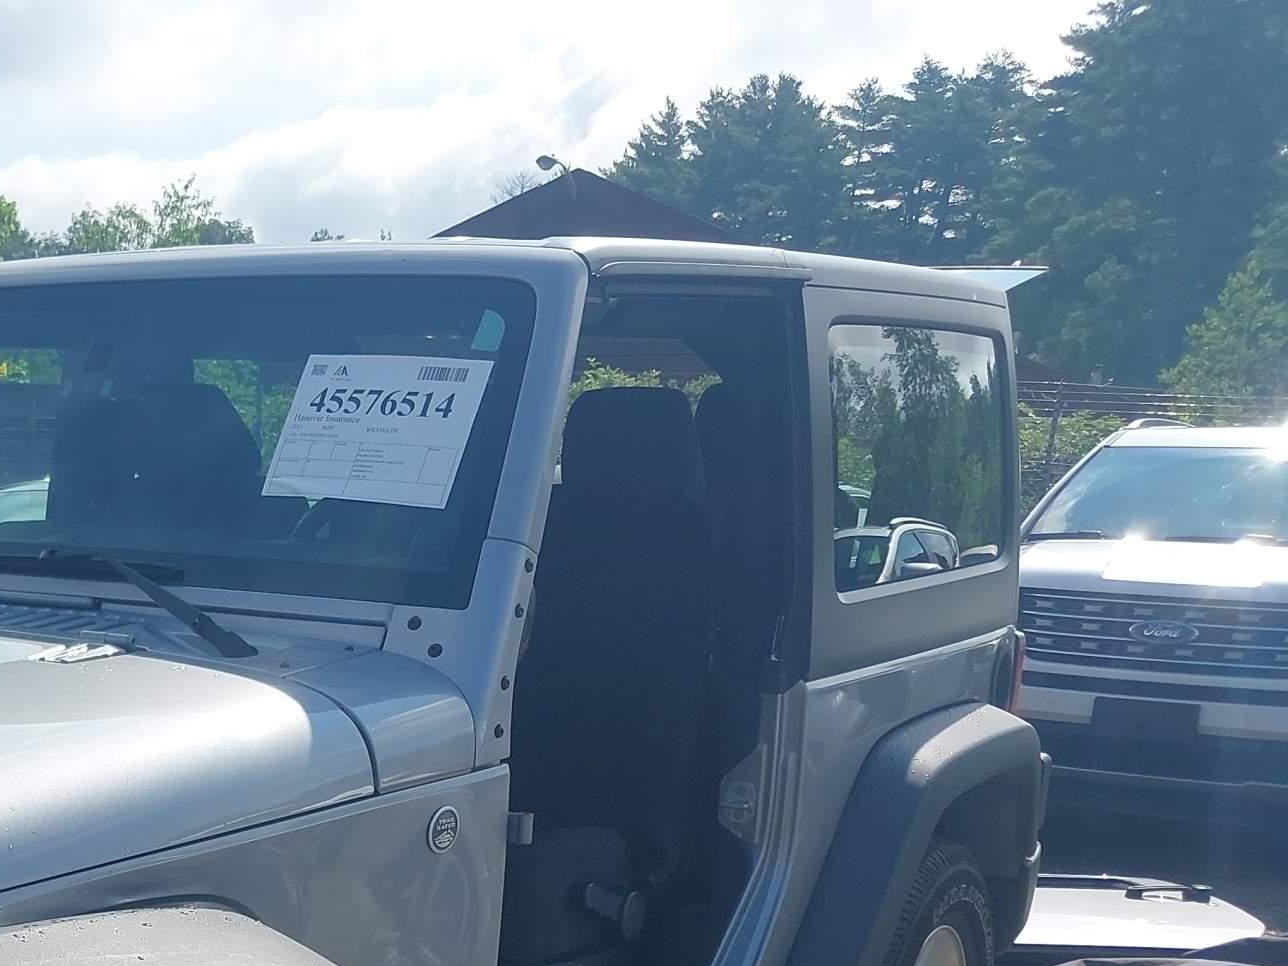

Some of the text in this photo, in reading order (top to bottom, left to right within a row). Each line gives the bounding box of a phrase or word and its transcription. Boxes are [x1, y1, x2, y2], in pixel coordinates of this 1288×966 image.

[309, 387, 456, 418] 45576514
[294, 413, 361, 424] Hanover Insurance
[1143, 625, 1183, 638] Ford
